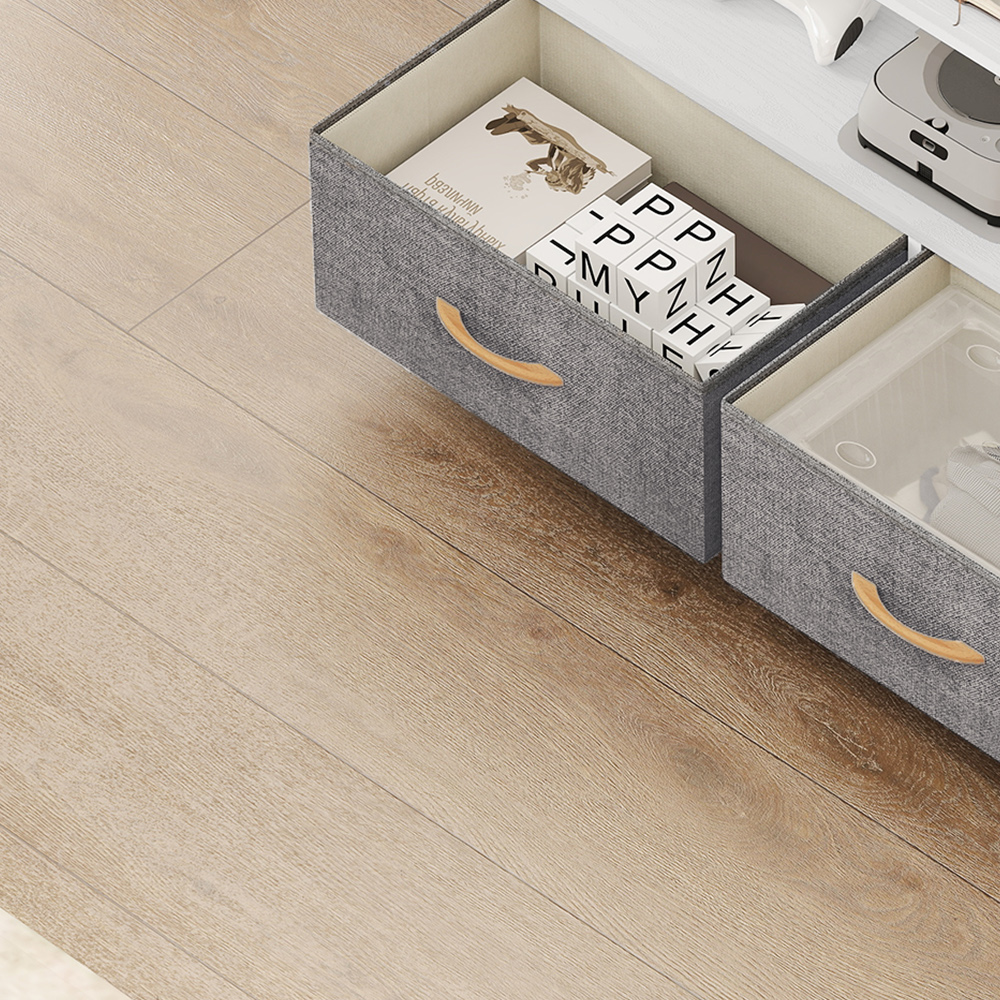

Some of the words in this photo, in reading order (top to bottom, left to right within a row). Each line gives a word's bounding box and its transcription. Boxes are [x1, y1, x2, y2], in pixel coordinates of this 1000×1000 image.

[632, 194, 675, 216] P
[593, 223, 635, 245] P
[674, 220, 717, 242] P
[581, 250, 610, 295] M
[634, 249, 677, 271] P
[624, 277, 650, 314] Y
[707, 283, 755, 316] H
[668, 312, 716, 346] H
